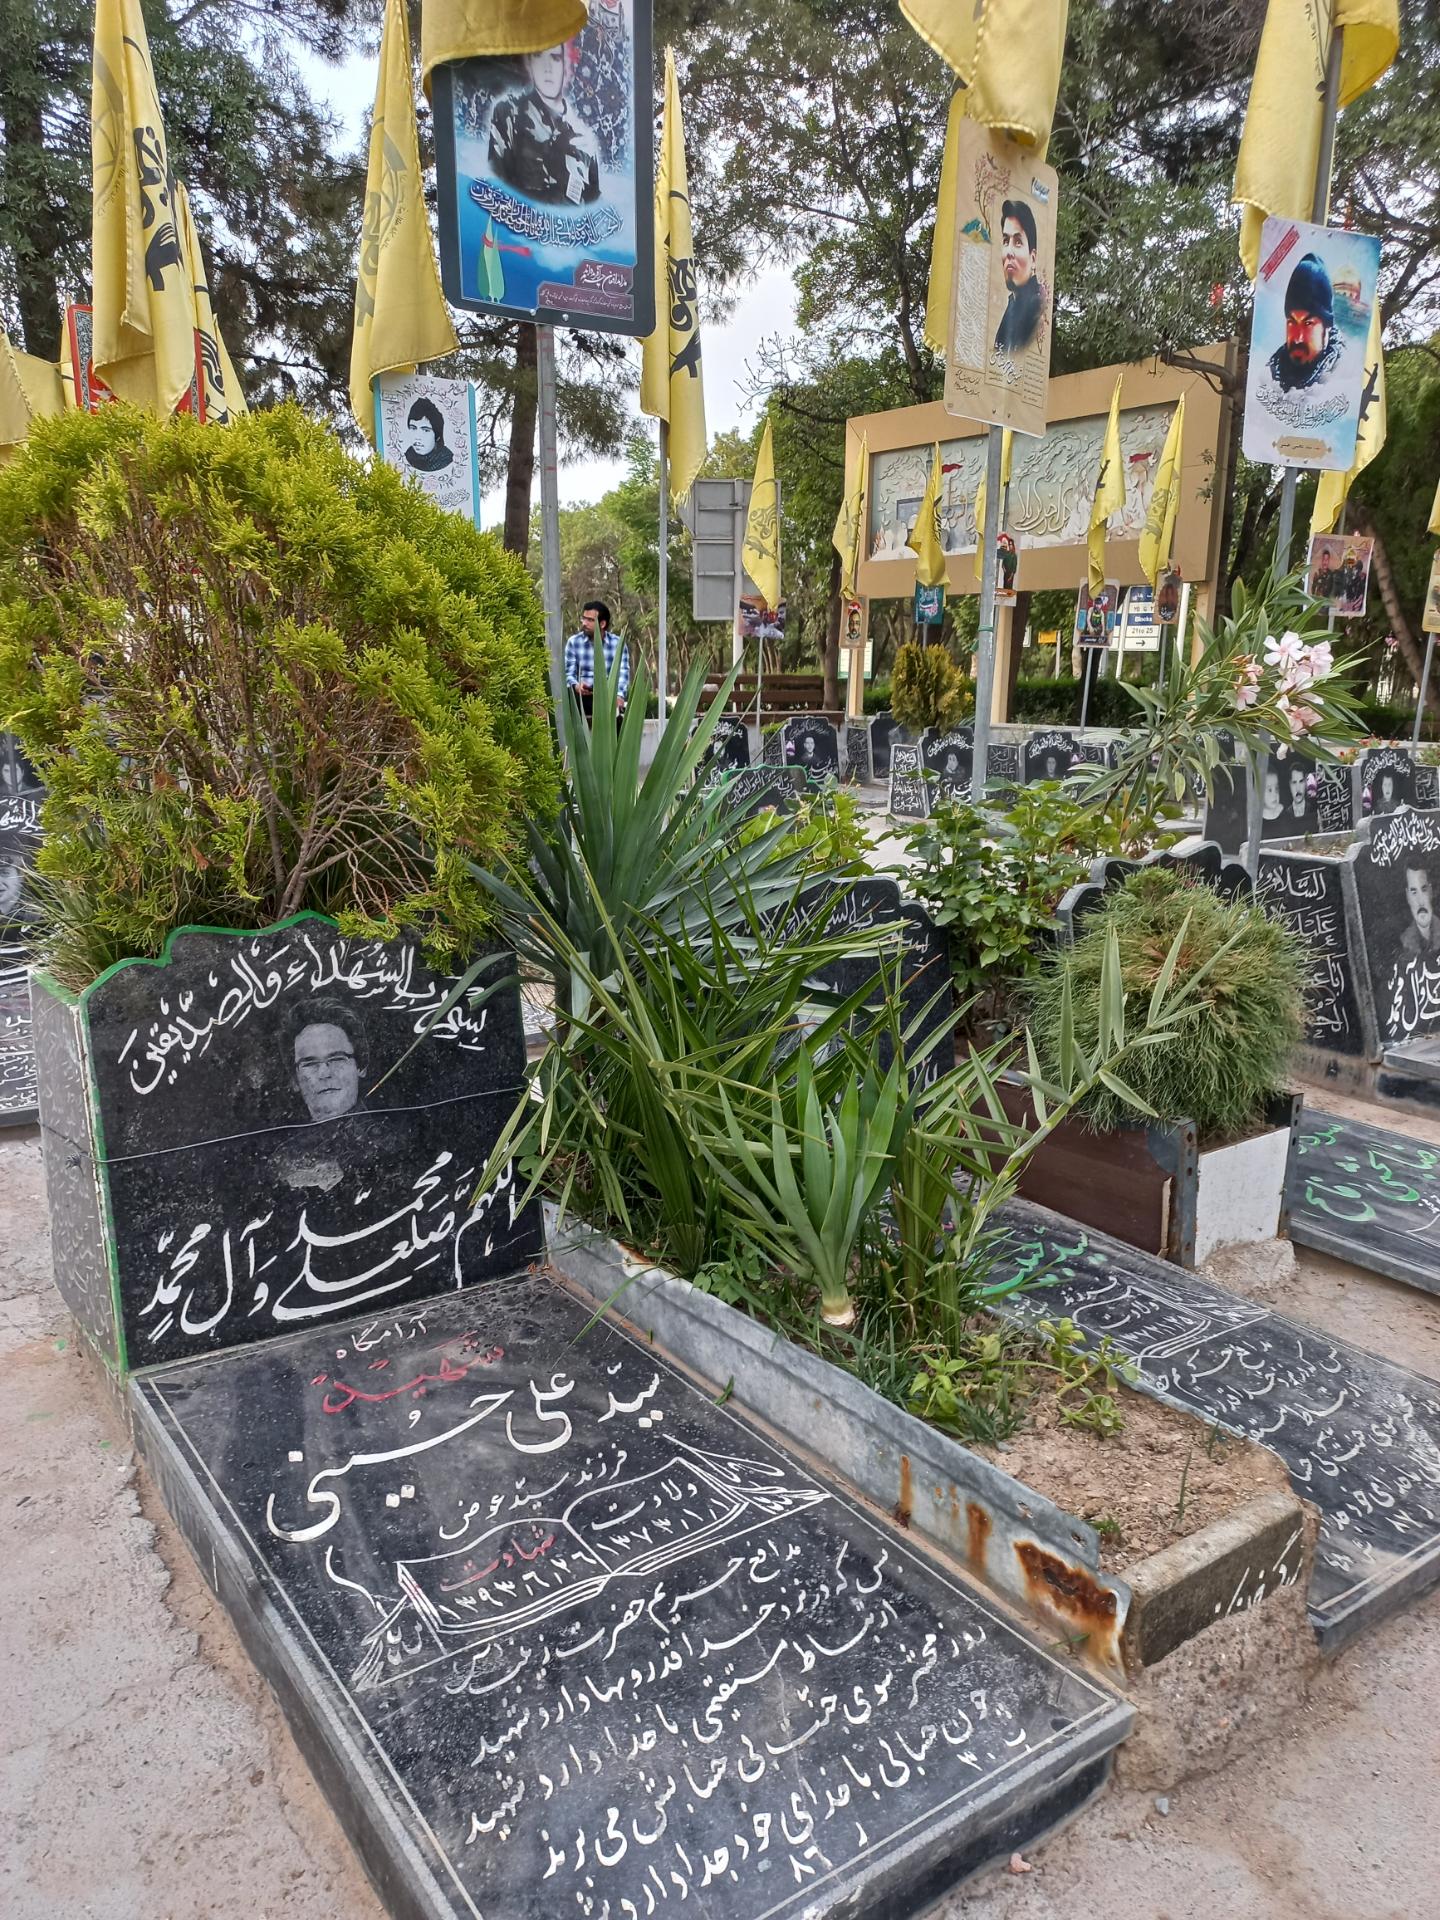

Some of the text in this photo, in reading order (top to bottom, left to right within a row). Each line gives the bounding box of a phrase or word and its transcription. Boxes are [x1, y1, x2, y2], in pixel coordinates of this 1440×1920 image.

[138, 1223, 212, 1342] محمد
[180, 1211, 273, 1336] آل
[334, 1310, 429, 1360] آرامگاه
[1099, 1299, 1161, 1330] ولادت
[505, 1372, 575, 1455] علی
[265, 1388, 517, 1543] حسینی
[573, 1442, 629, 1488] فرزند
[438, 1493, 506, 1541] عوض
[590, 1477, 700, 1532] ولادت
[439, 1524, 557, 1593] شهادت
[747, 1540, 803, 1584] مدافع
[834, 1540, 850, 1596] که
[856, 1547, 904, 1594] بس
[647, 1556, 746, 1635] حریم
[811, 1583, 830, 1611] در
[554, 1597, 646, 1662] حضرت
[681, 1601, 778, 1660] خدا
[646, 1637, 682, 1685] قدر
[464, 1598, 899, 1845] ارتباط مستقیمی با خدا دارد شهید
[538, 1684, 592, 1730] دارد
[843, 1668, 894, 1726] سوی
[470, 1695, 531, 1767] شهید
[631, 1755, 729, 1846] حسابش
[780, 1766, 851, 1846] خدای
[841, 1754, 882, 1800] با
[542, 1826, 587, 1880] برند
[594, 1806, 629, 1867] می
[733, 1802, 773, 1862] خود
[675, 1841, 739, 1888] جدا
